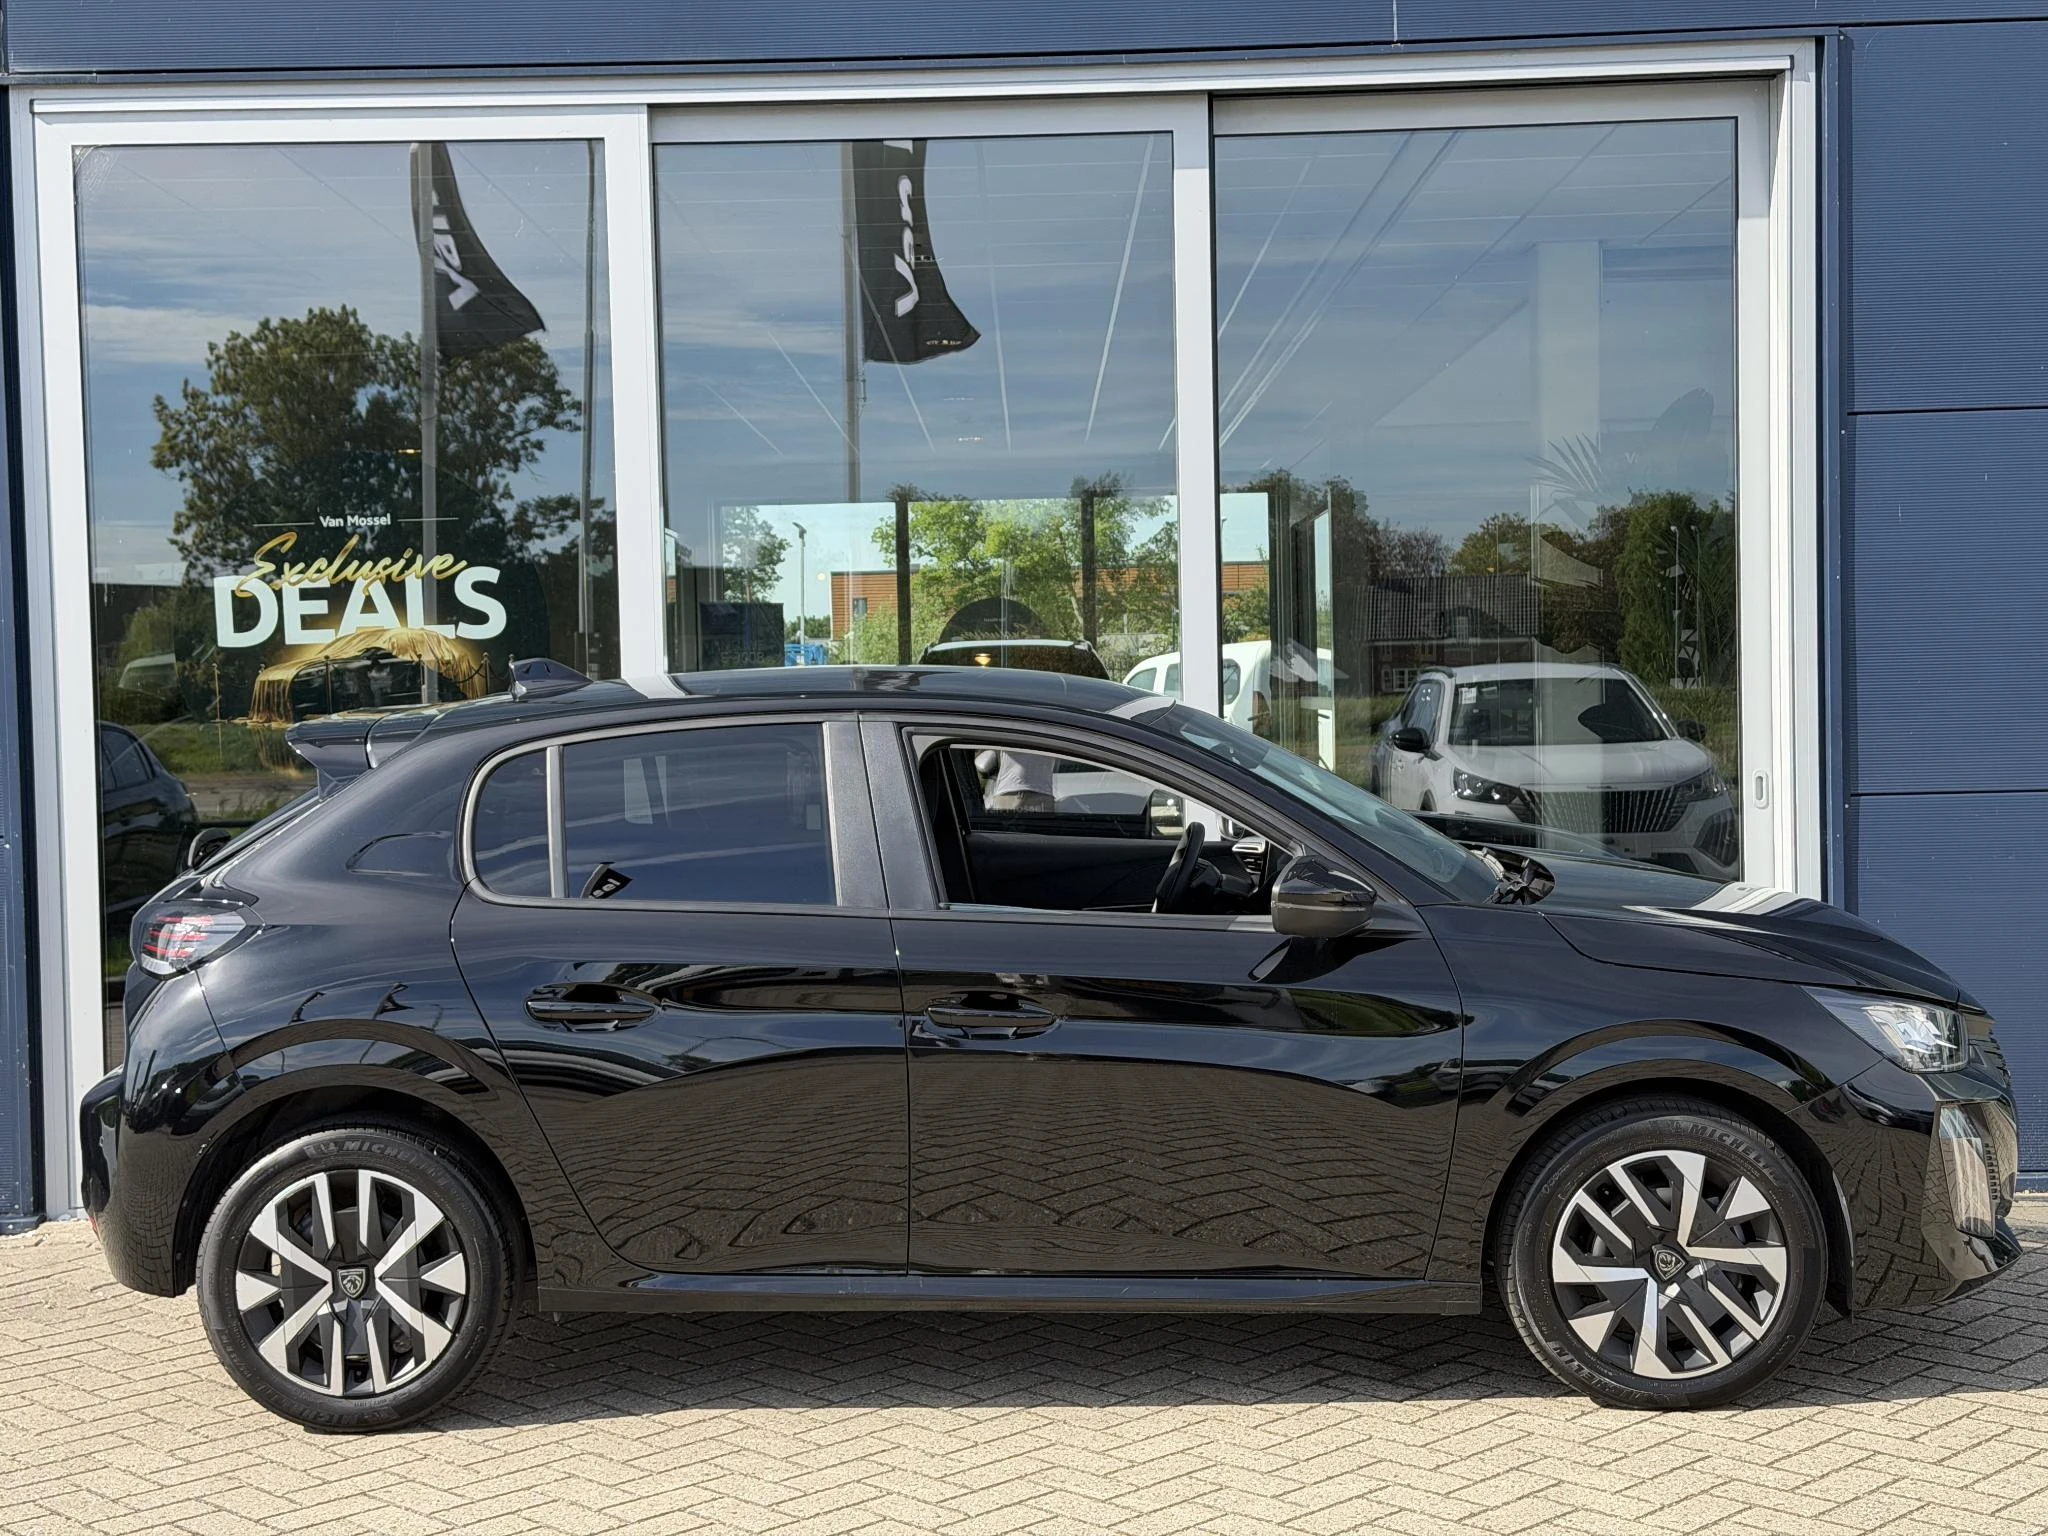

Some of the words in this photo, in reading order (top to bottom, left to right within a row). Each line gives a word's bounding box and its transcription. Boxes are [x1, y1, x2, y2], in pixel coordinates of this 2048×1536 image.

[319, 515, 344, 528] Van
[346, 513, 391, 527] Mossel
[234, 531, 468, 598] Exclusive
[213, 565, 507, 648] DEALS
